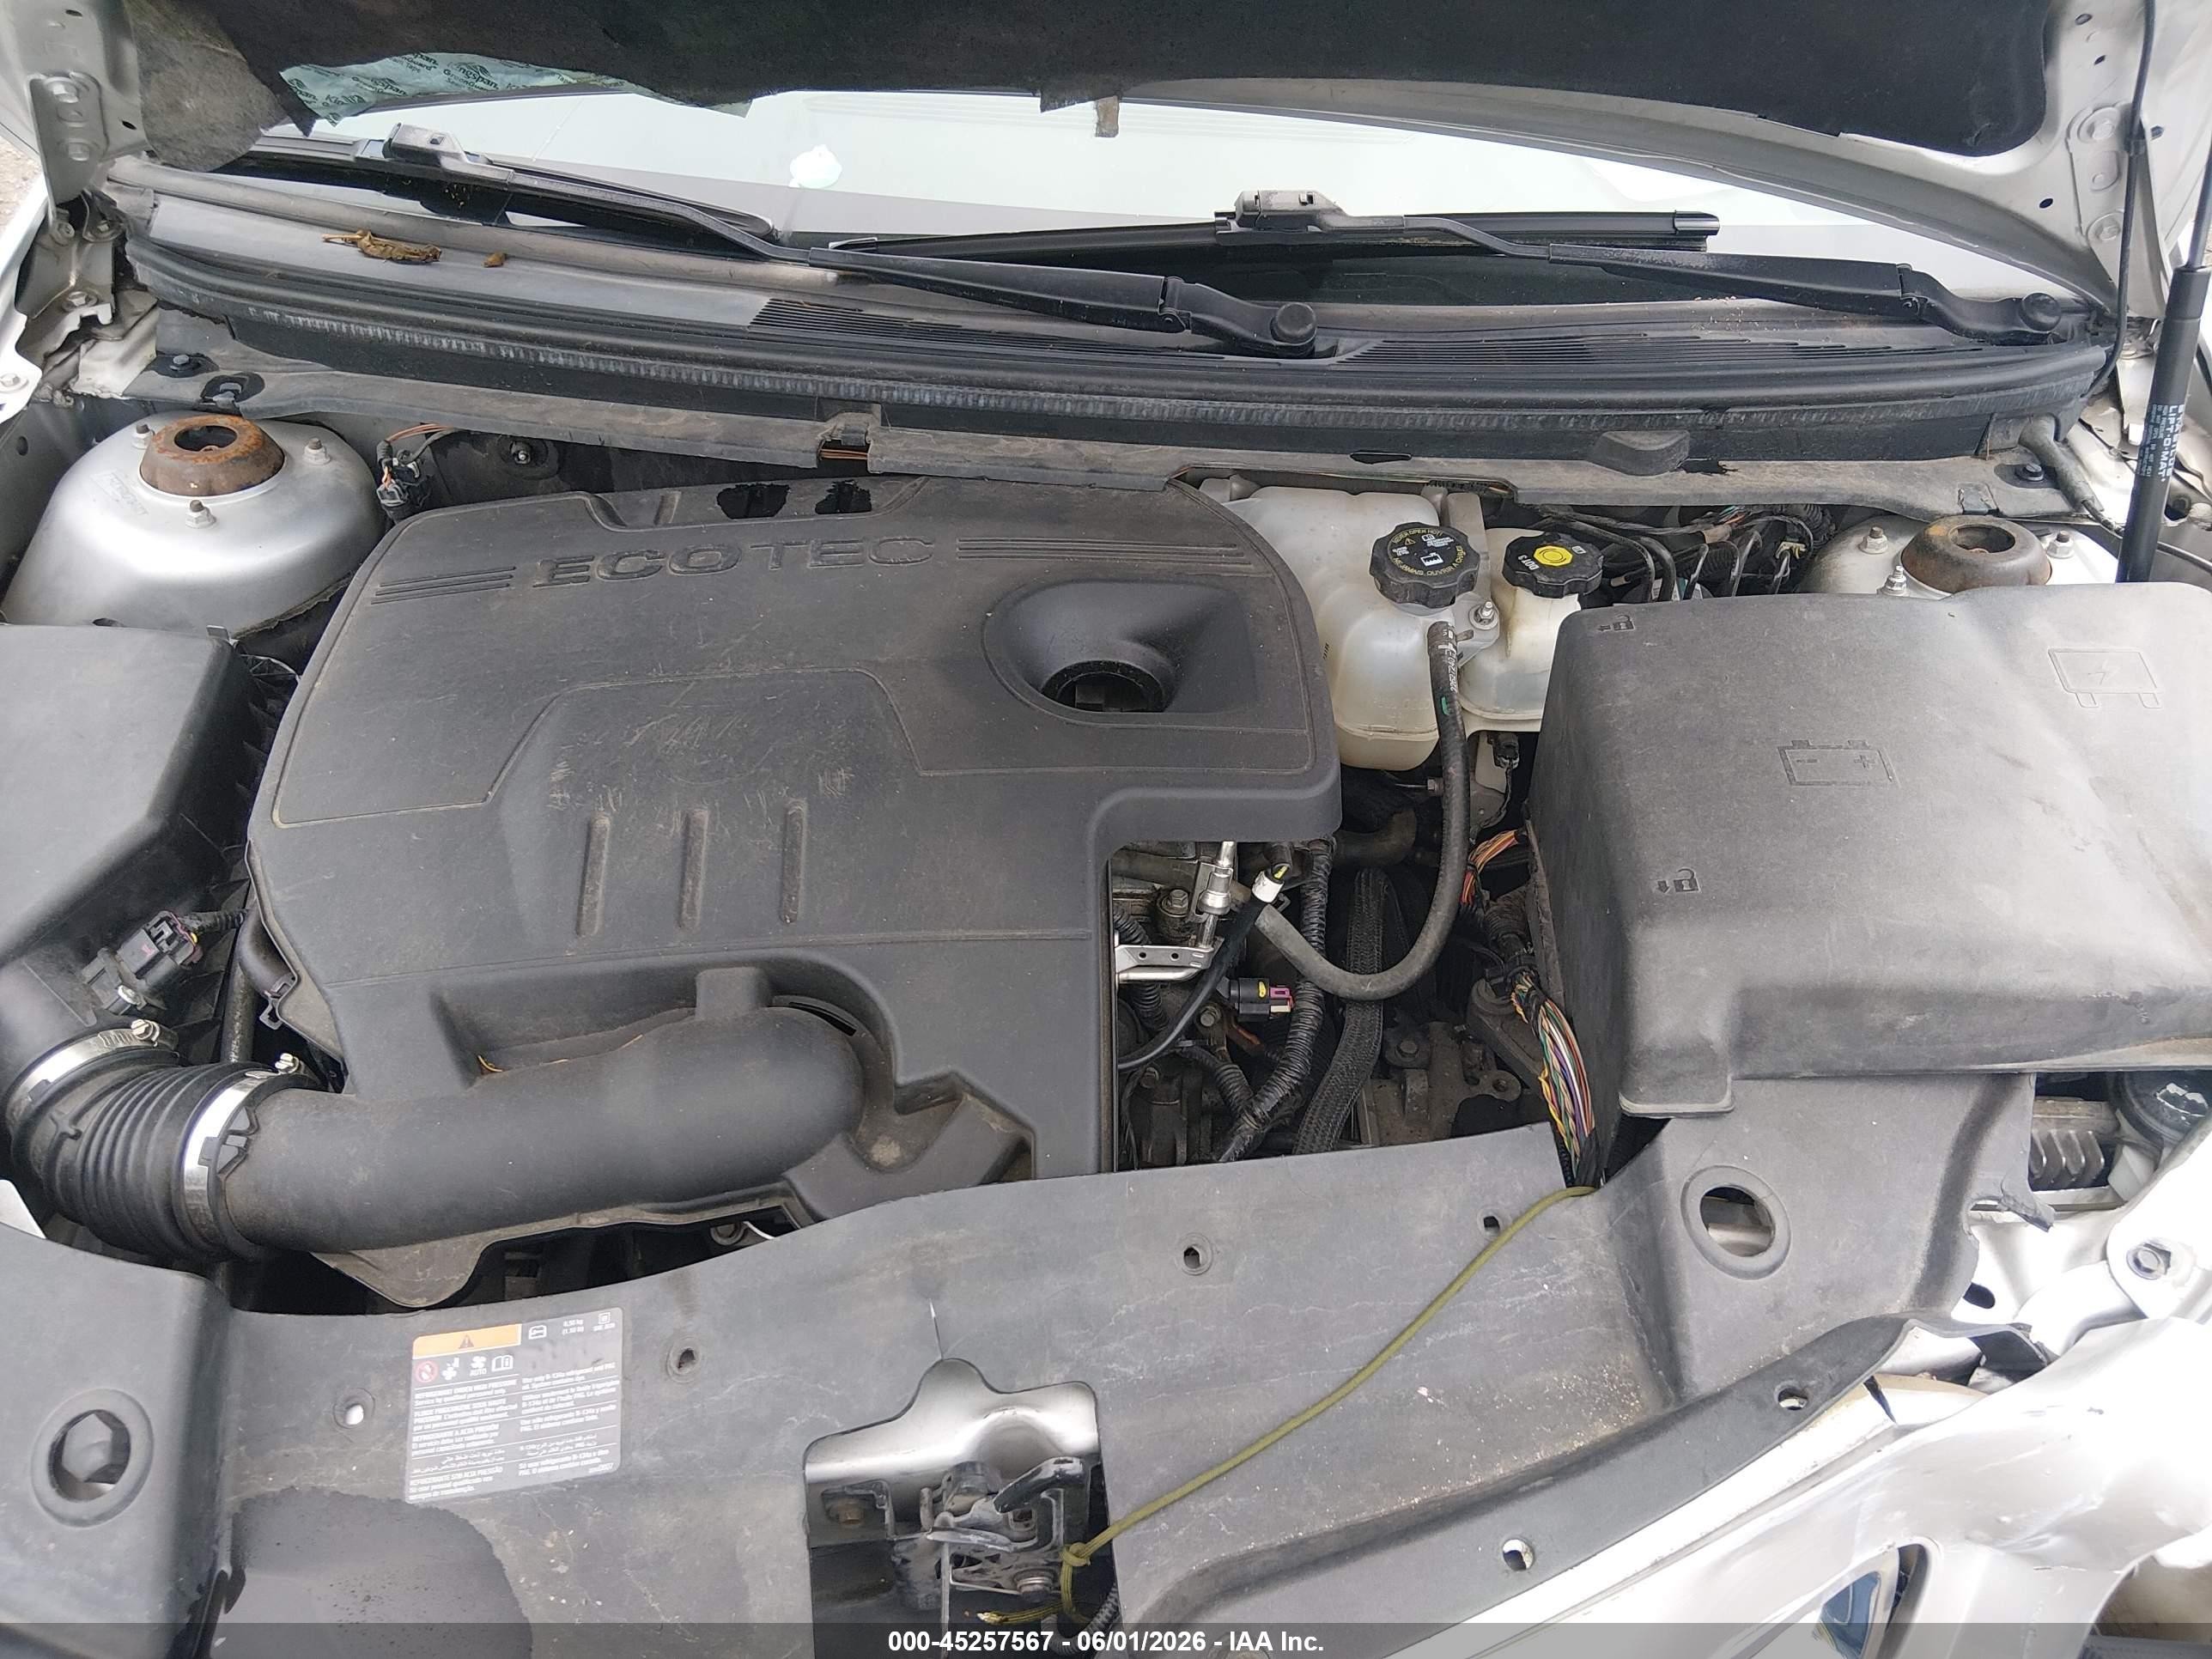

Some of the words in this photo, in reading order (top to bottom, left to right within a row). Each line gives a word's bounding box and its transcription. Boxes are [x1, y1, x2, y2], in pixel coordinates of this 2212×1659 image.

[532, 538, 934, 588] ECOTEC
[1521, 558, 1540, 570] DOT
[469, 1368, 487, 1376] AUTO
